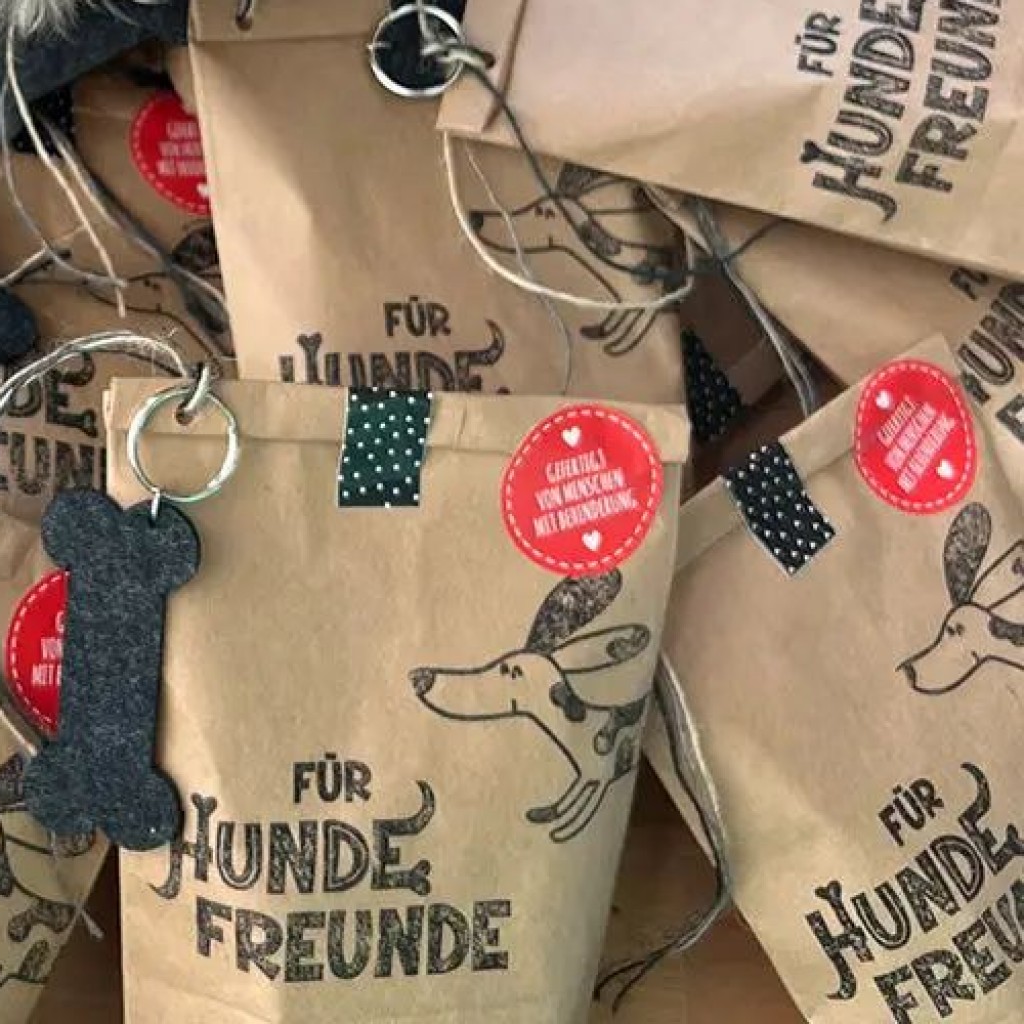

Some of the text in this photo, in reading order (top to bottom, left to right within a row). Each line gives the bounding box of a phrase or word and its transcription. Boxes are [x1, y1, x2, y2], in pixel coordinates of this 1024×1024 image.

[795, 11, 841, 77] FÜR
[383, 295, 451, 337] FÜR
[32, 663, 55, 687] MIT
[292, 752, 372, 804] FÜR
[878, 778, 944, 848] FÜR
[149, 779, 436, 900] HUNDE
[805, 761, 1024, 1000] HUNDE
[195, 895, 511, 983] FREUNDE
[873, 878, 1024, 1024] FREU
